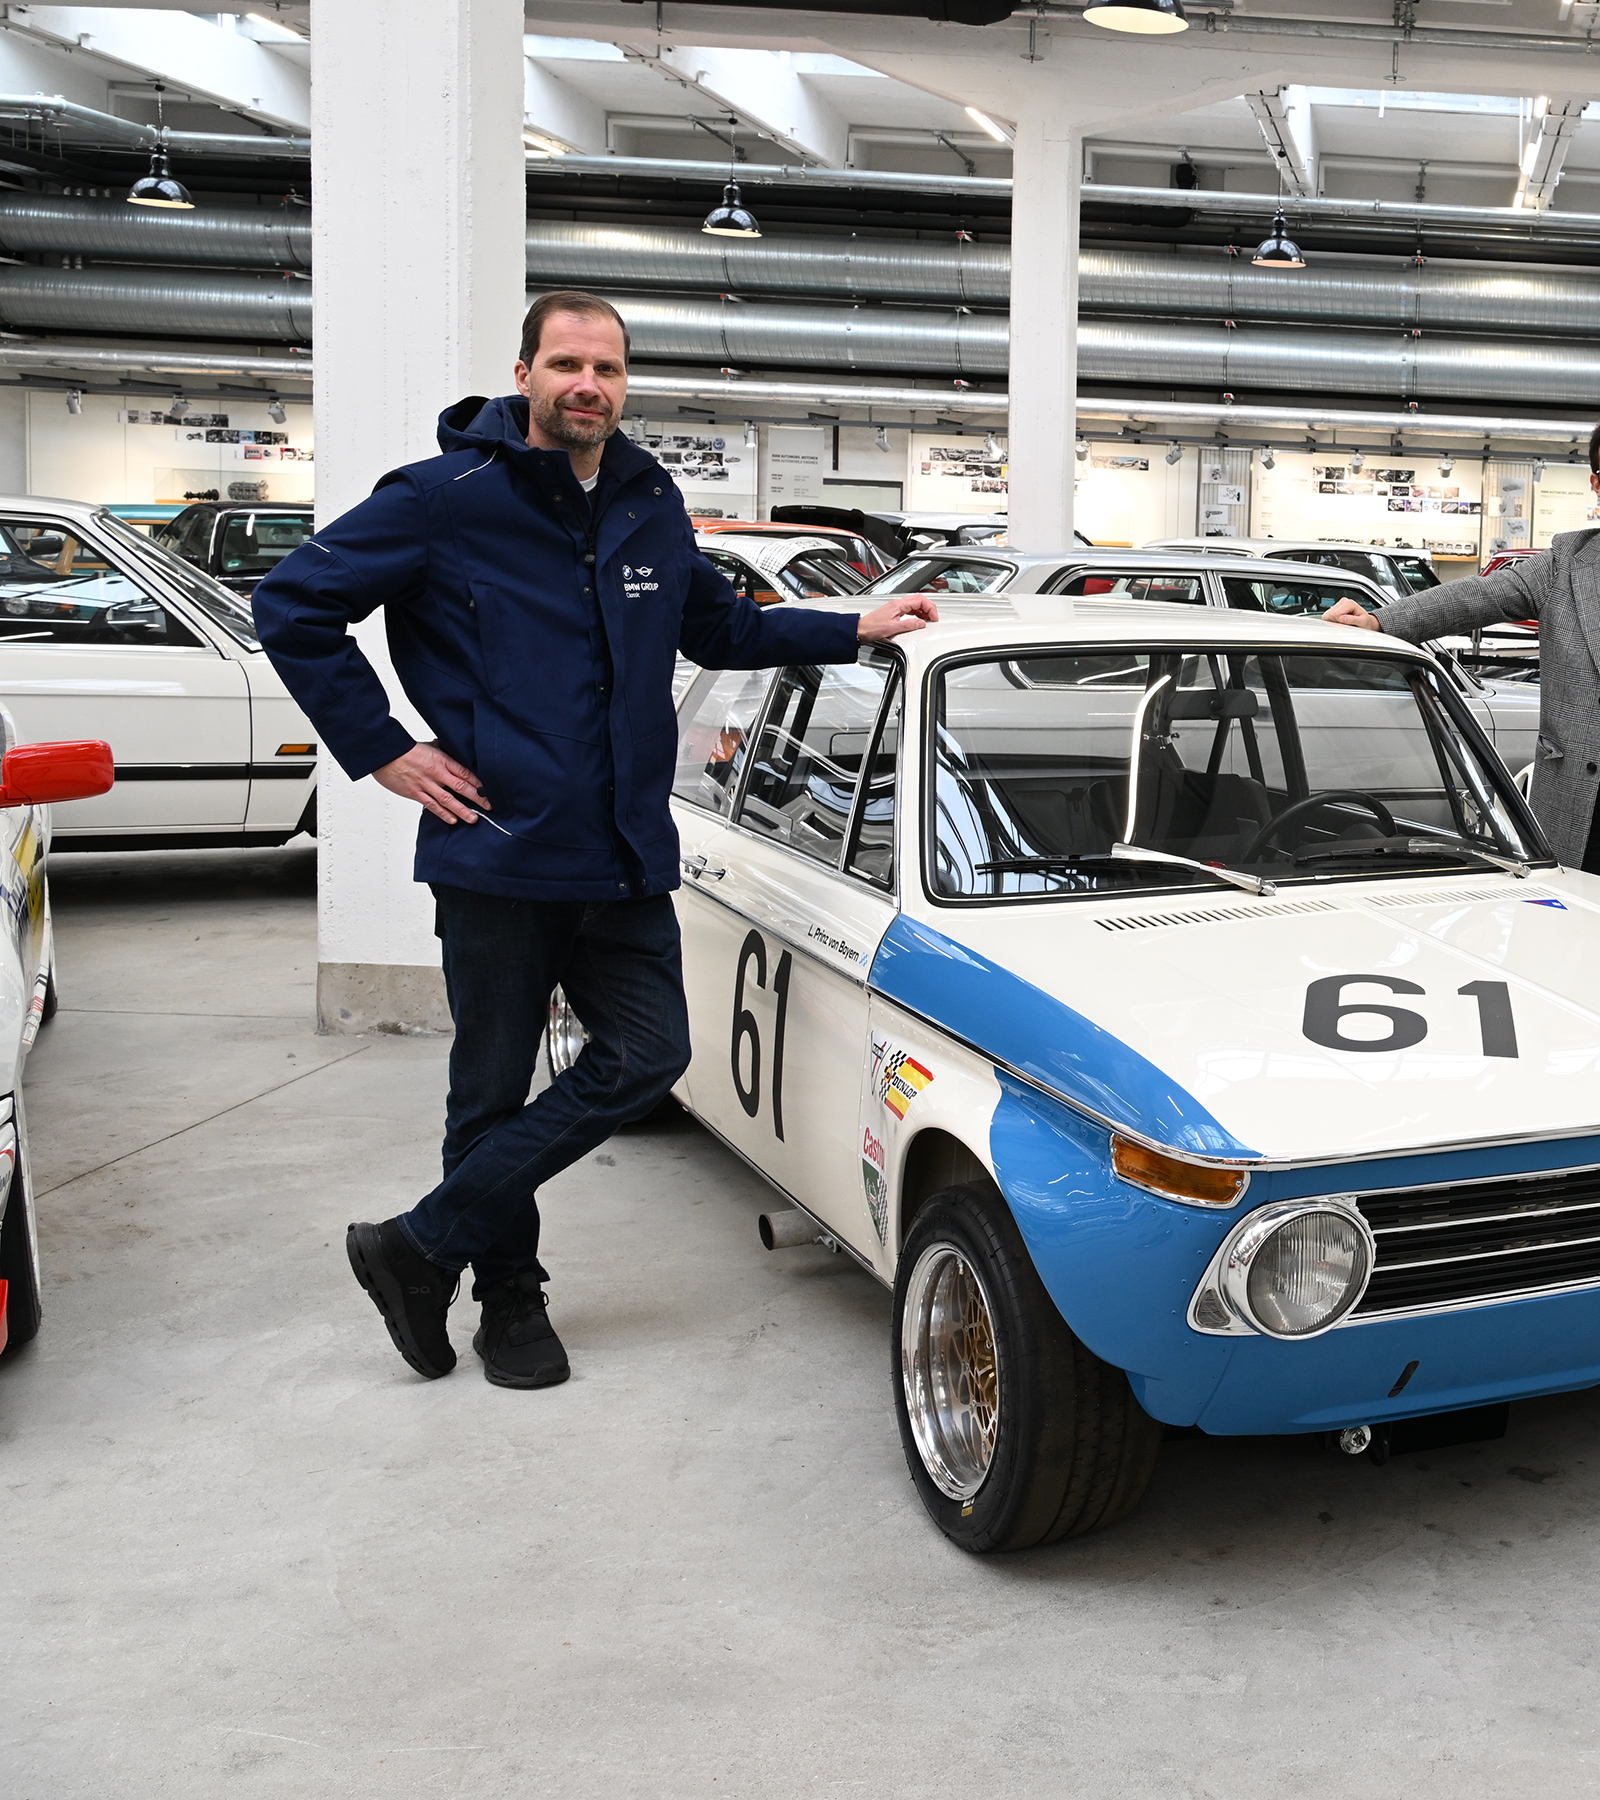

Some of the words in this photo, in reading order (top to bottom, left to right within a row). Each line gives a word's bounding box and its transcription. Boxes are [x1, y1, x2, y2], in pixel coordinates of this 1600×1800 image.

[624, 583, 640, 591] BMW
[641, 582, 659, 591] GROUP
[813, 927, 829, 945] Prinz
[828, 938, 839, 951] von
[838, 940, 859, 962] Bayern
[1301, 973, 1520, 1059] 61
[730, 928, 793, 1143] 61
[892, 1076, 918, 1100] DUNLOP
